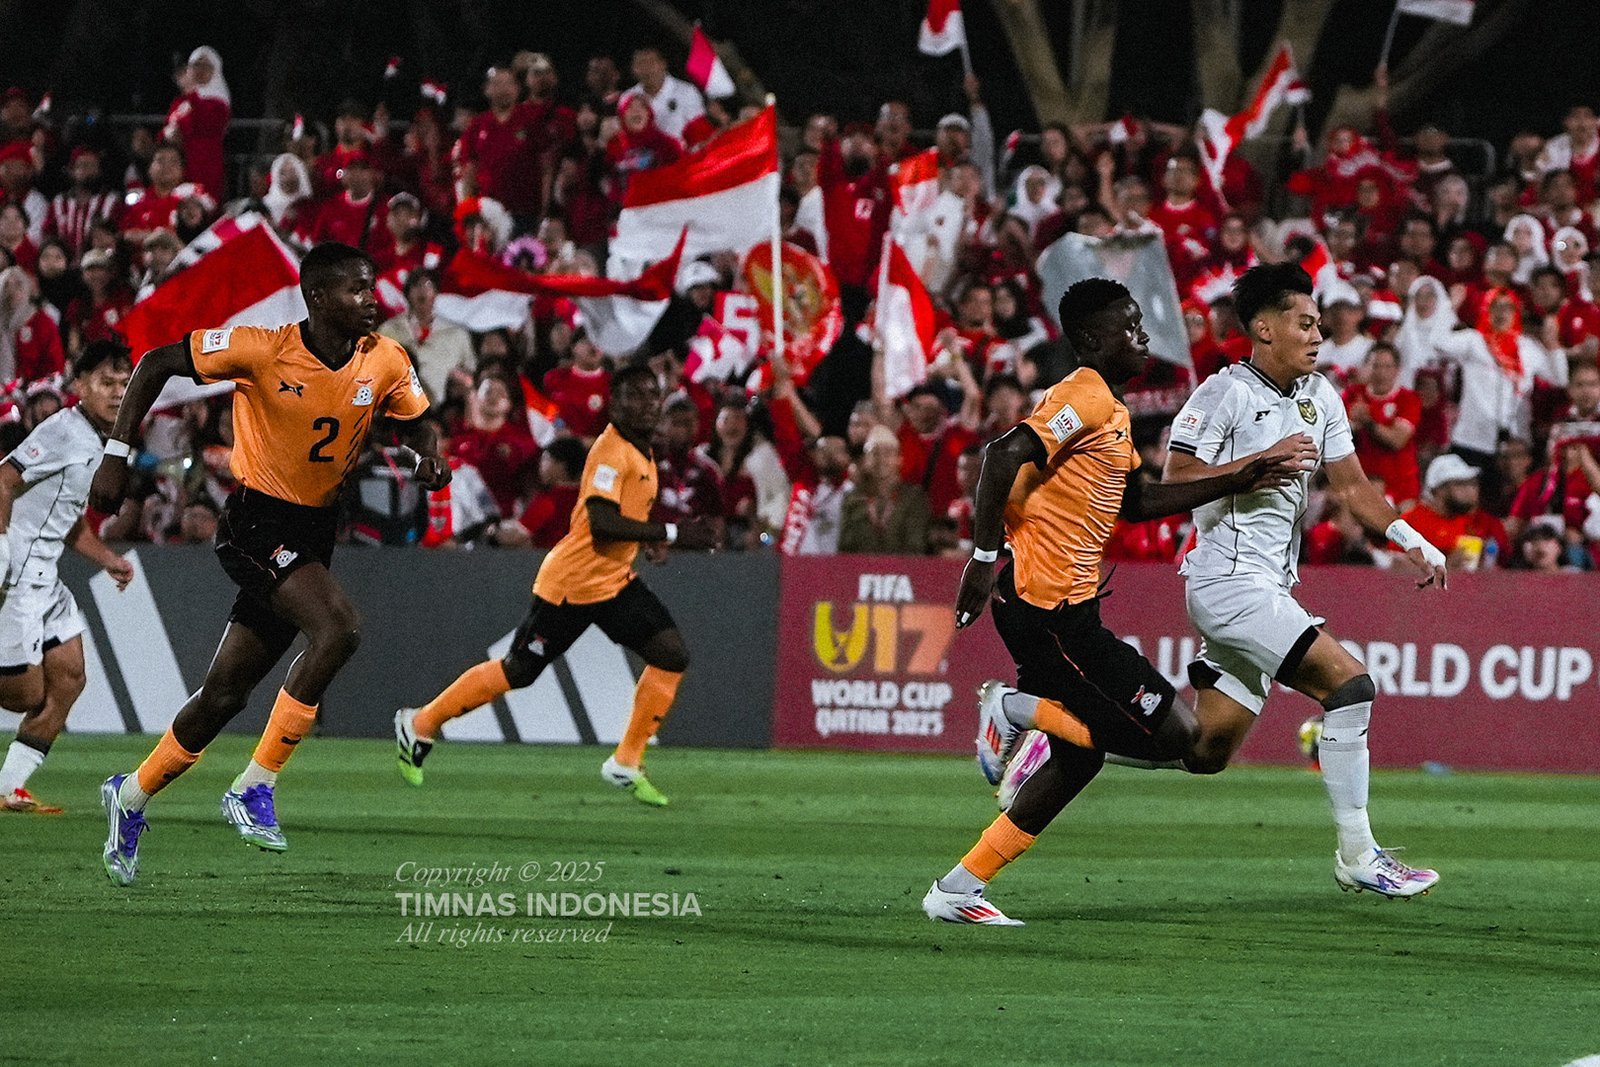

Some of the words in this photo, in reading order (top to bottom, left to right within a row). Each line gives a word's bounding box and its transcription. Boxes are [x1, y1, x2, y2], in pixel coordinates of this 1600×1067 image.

[308, 416, 340, 462] 2
[858, 573, 913, 601] FIFA
[814, 601, 957, 674] U17
[1479, 644, 1593, 701] CUP
[811, 679, 900, 708] WORLD
[902, 682, 953, 709] CUP
[815, 708, 890, 738] QATAR
[891, 710, 945, 736] 2025
